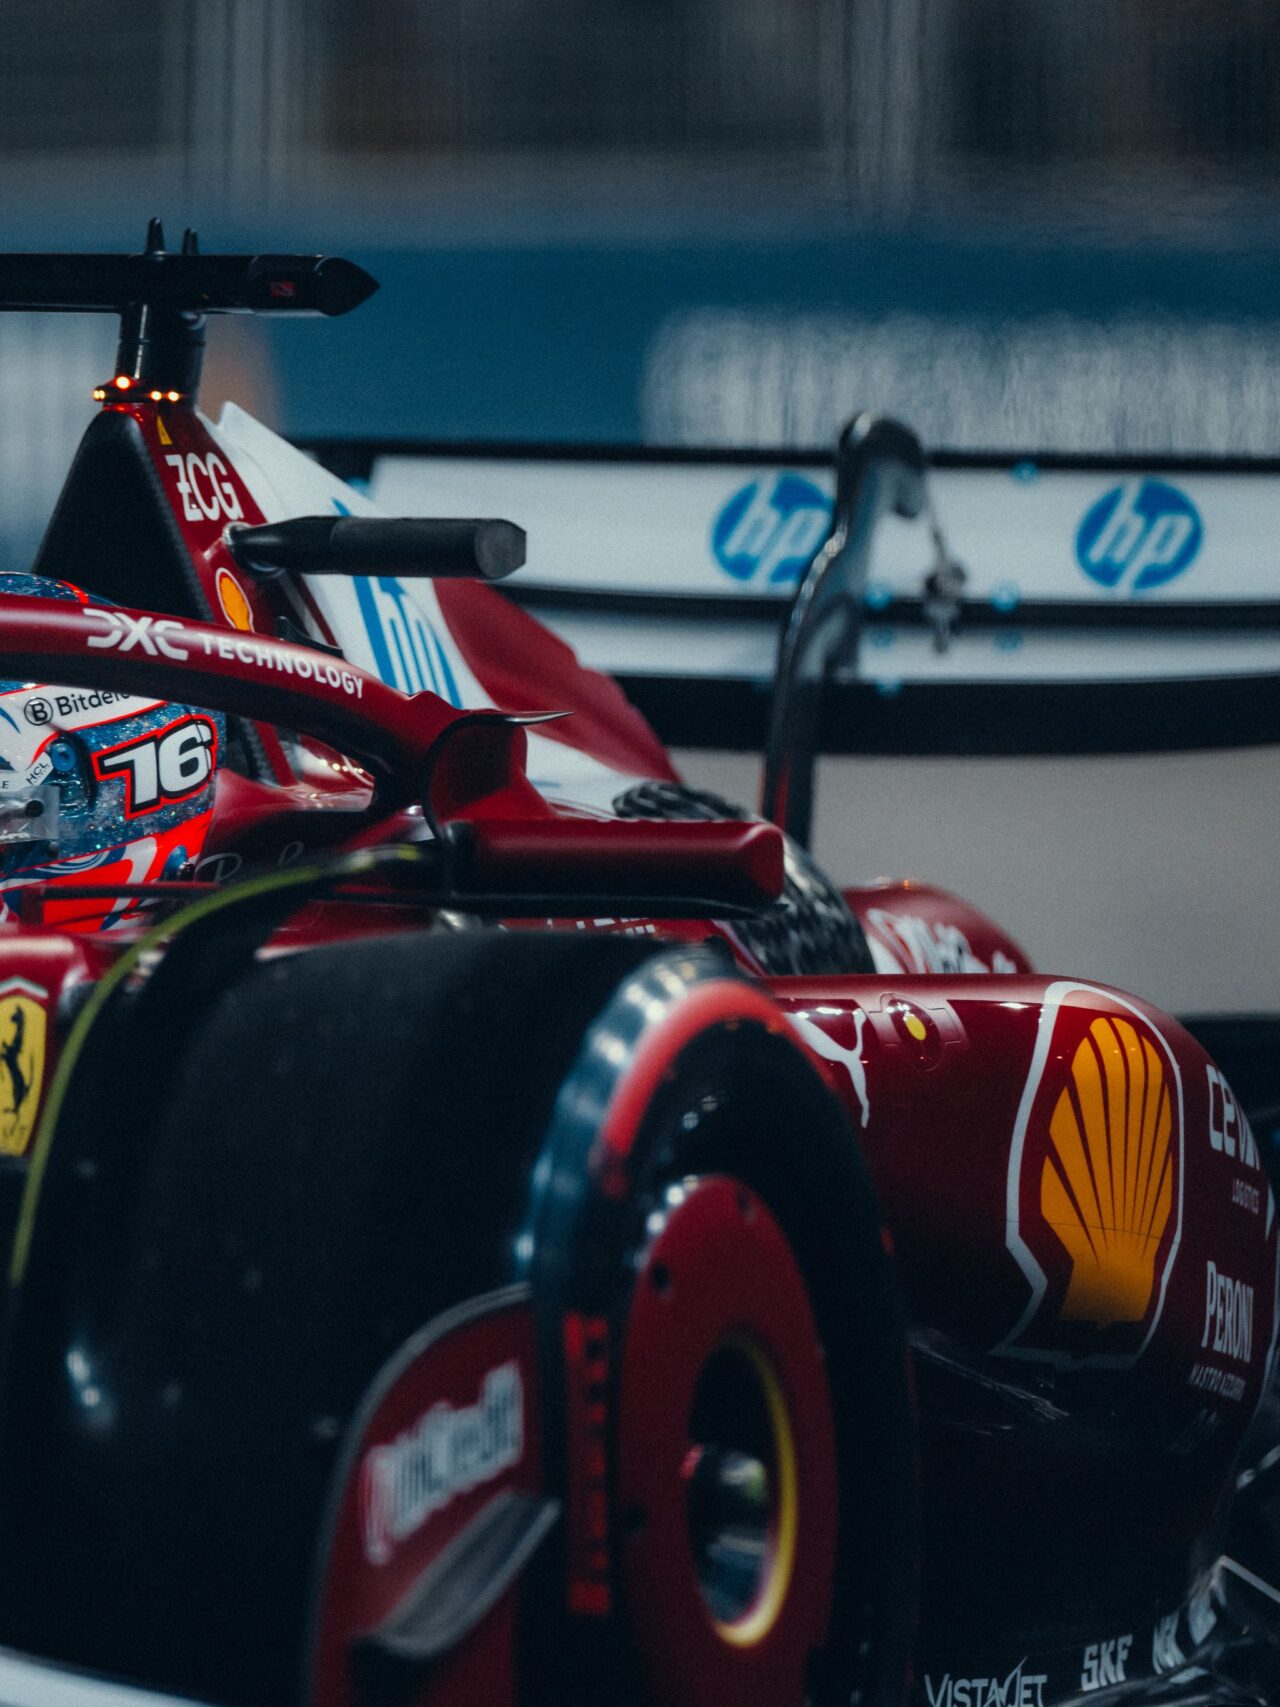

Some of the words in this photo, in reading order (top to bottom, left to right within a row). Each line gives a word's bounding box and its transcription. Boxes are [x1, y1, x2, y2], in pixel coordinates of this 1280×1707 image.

[165, 452, 245, 521] ZCG
[722, 472, 830, 584] hp
[1089, 478, 1194, 598] hp
[82, 608, 189, 661] DXC
[198, 633, 363, 698] TECHNOLOGY
[1201, 1261, 1254, 1363] PERONI
[1081, 1634, 1133, 1692] SKF
